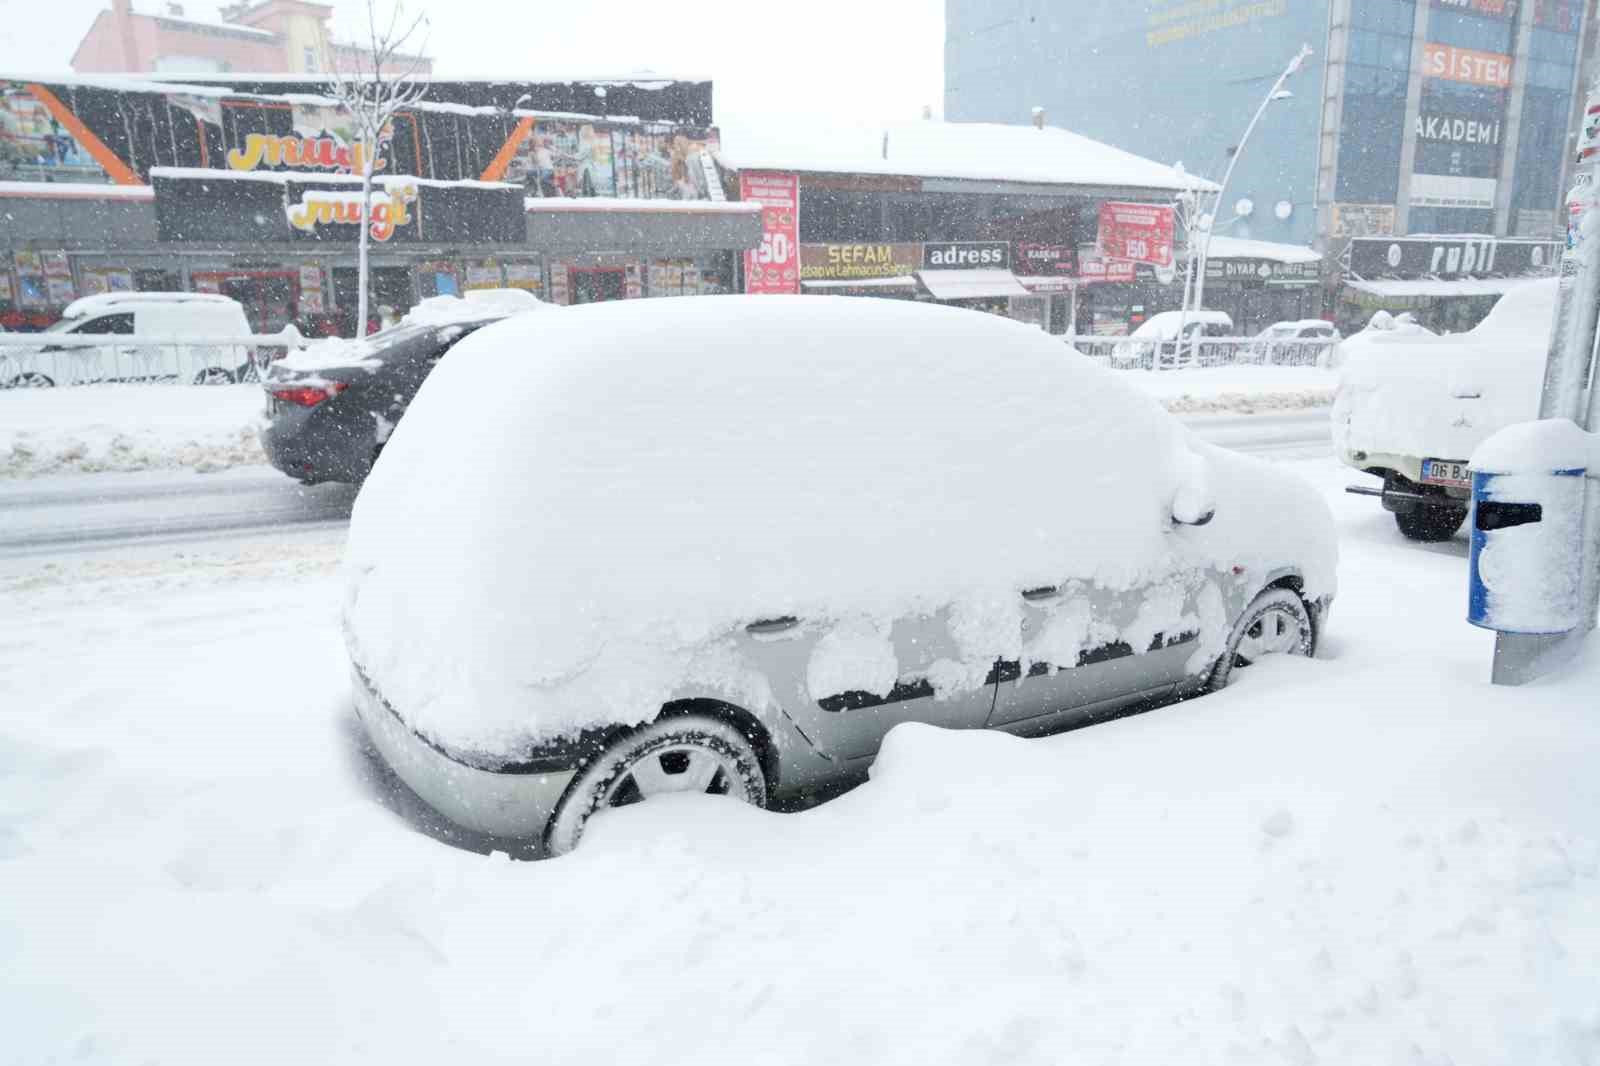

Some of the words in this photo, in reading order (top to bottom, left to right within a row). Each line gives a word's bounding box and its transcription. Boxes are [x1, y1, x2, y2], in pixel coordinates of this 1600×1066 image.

[828, 245, 892, 263] SEFAM
[930, 245, 1002, 265] adress
[1432, 464, 1448, 477] 06
[1452, 465, 1472, 480] BJ
